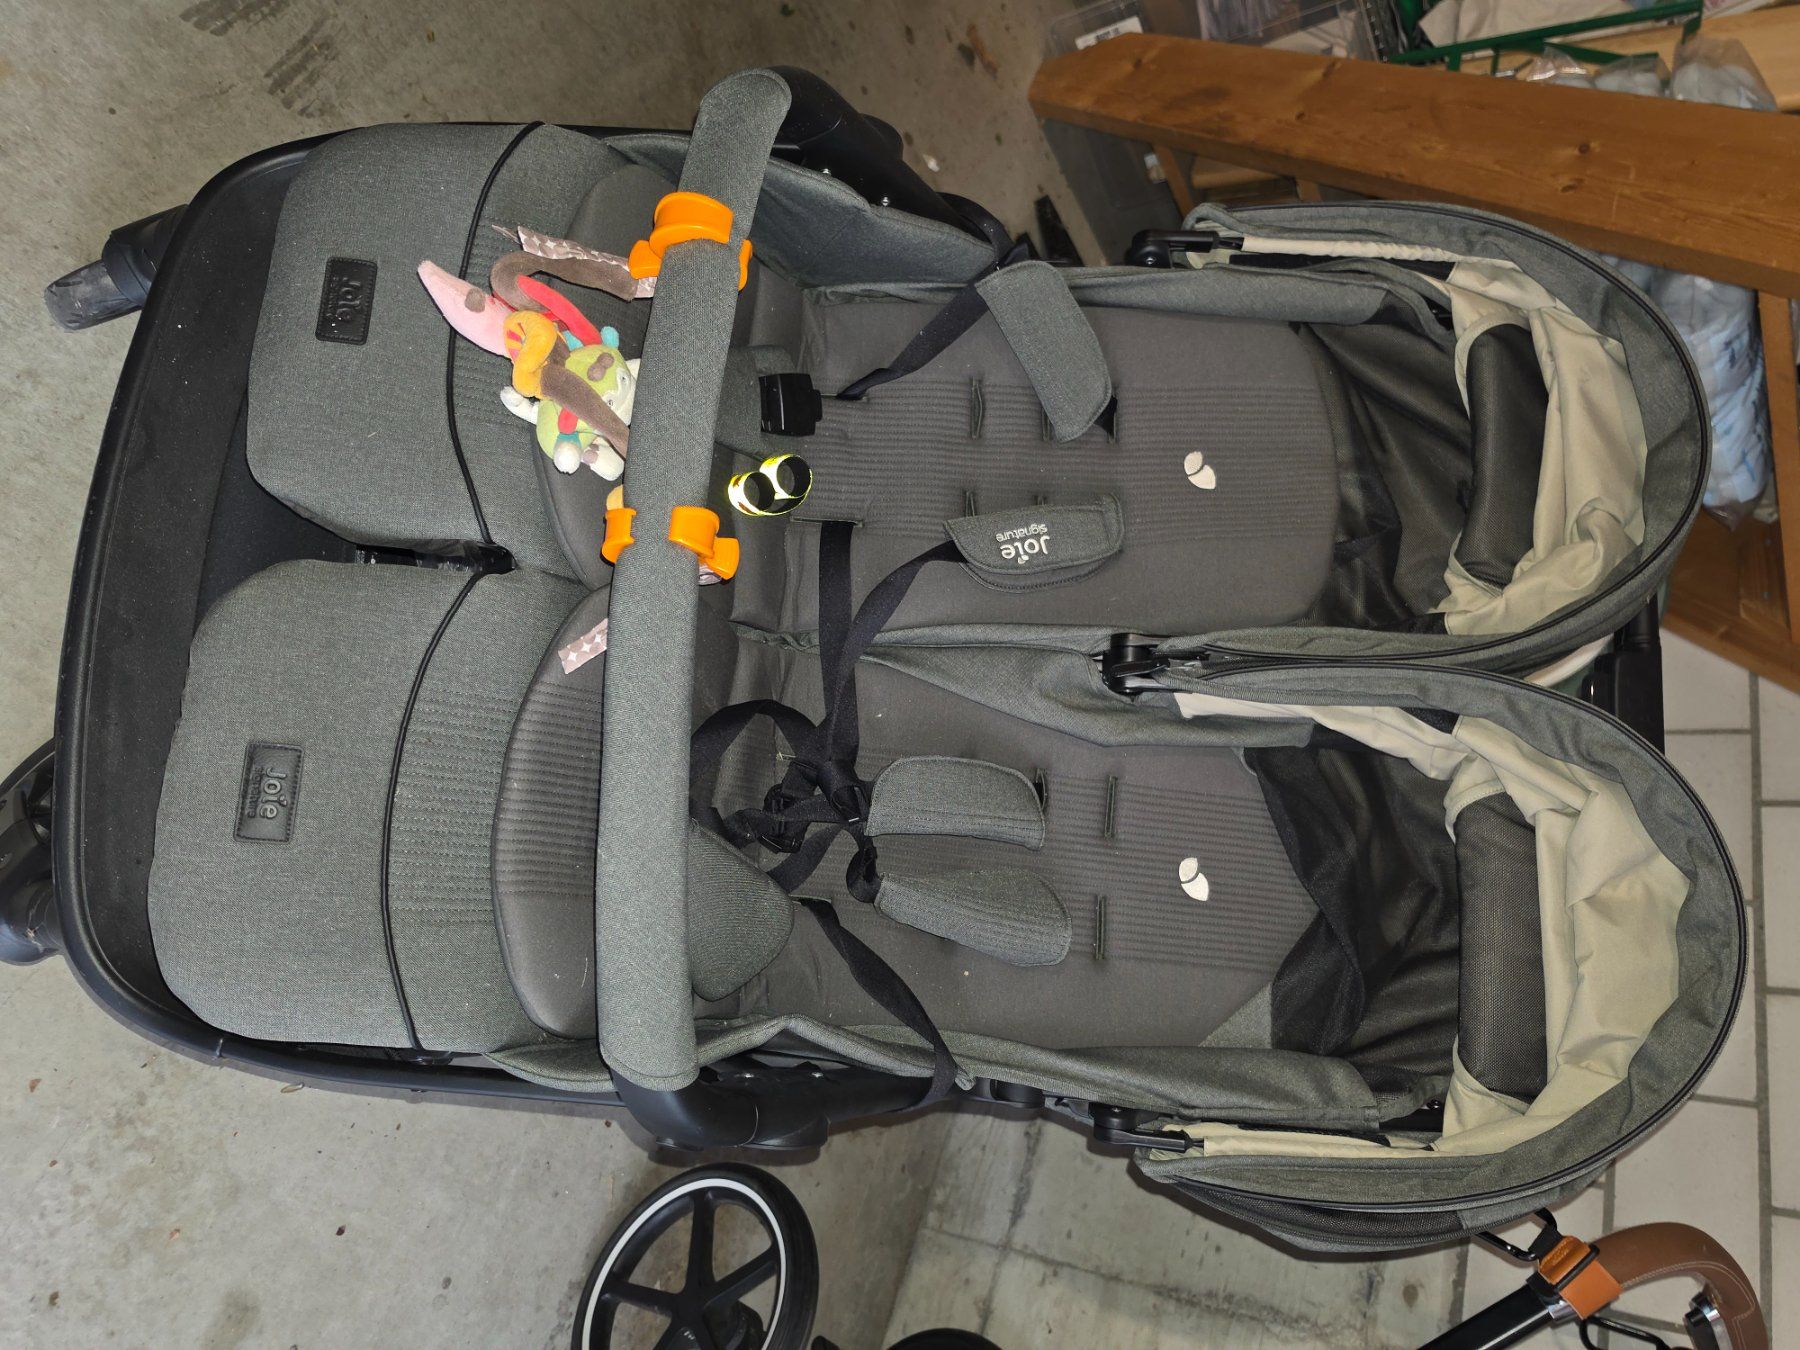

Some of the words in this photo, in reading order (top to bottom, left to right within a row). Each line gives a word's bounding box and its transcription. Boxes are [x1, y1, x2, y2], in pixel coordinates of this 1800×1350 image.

[996, 523, 1048, 543] signature
[1000, 535, 1050, 565] Joie
[260, 767, 287, 818] Joie
